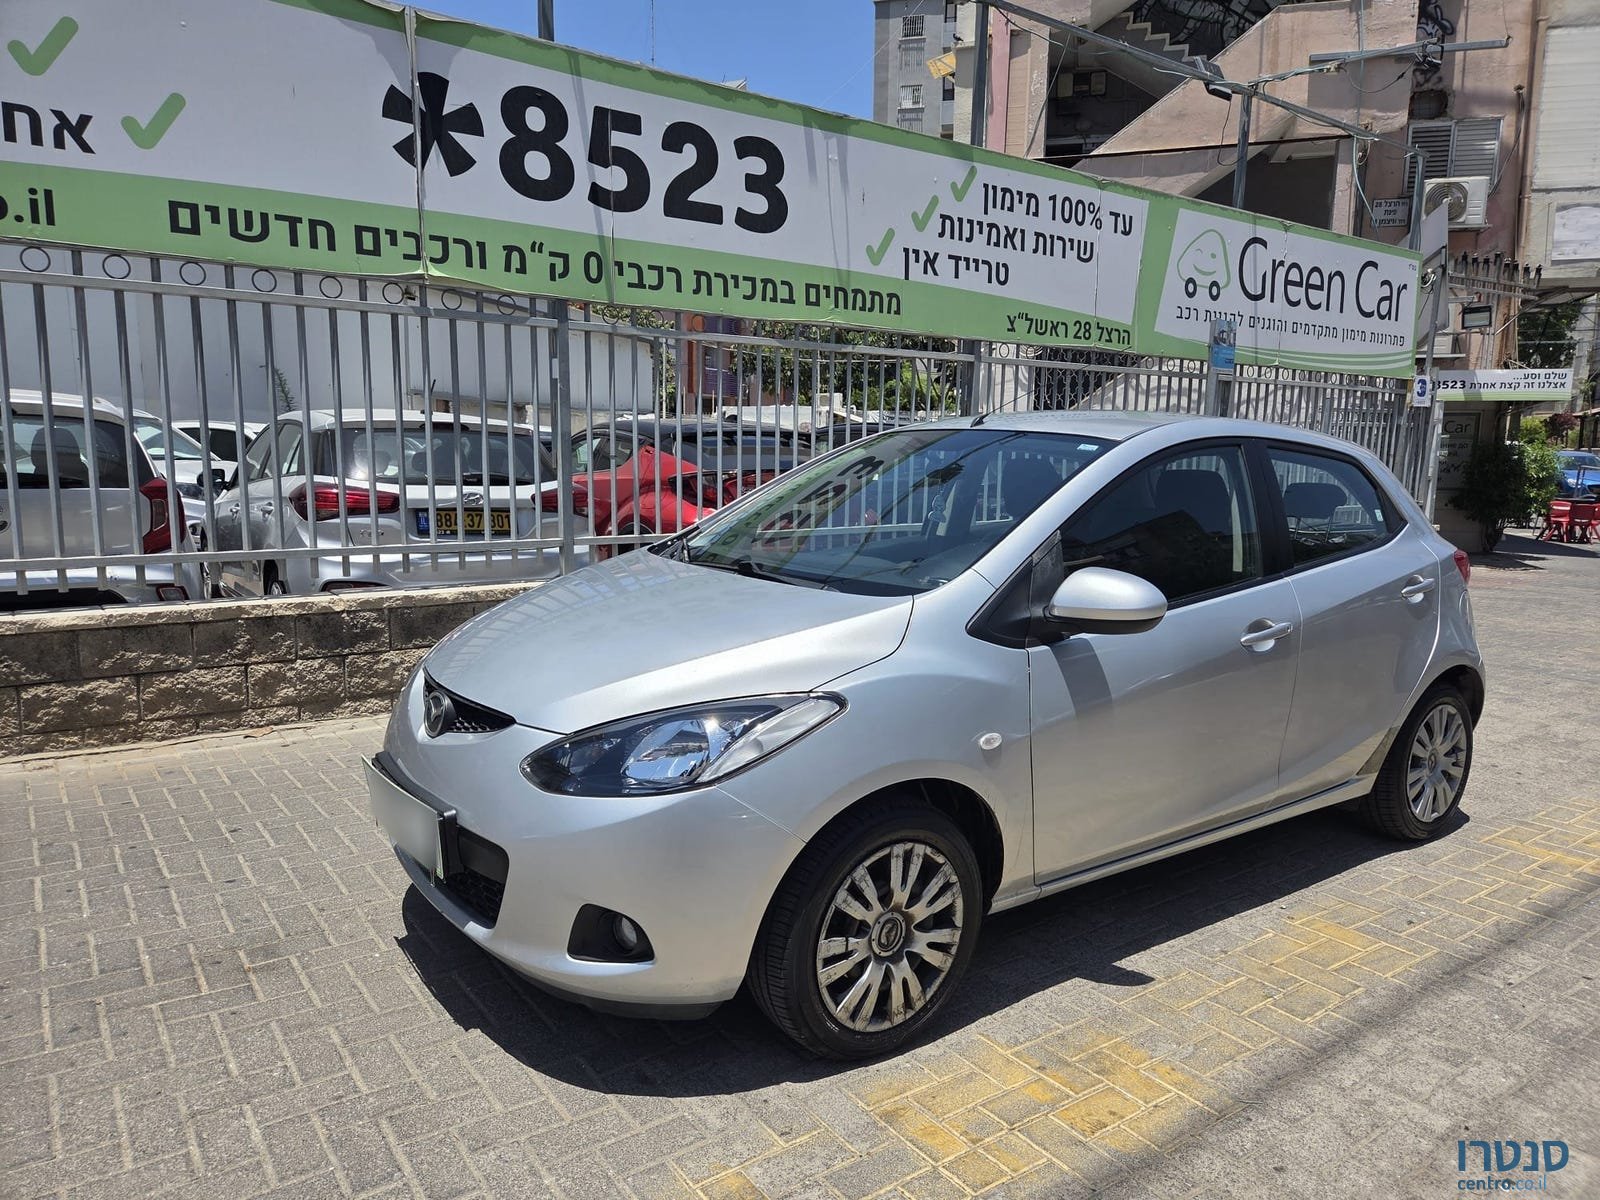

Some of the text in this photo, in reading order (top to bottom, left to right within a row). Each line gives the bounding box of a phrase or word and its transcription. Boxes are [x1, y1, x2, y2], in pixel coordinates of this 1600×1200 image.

[983, 182, 1133, 237] עד 100% מימון
[168, 199, 337, 252] חדשים
[355, 224, 487, 270] ורכבים
[938, 213, 1094, 264] שירות ואמינות
[583, 250, 604, 284] 0
[614, 260, 683, 293] רכבי
[902, 247, 1010, 286] טרייד אין
[692, 269, 796, 305] במכירת
[1238, 236, 1408, 322] Green Car
[804, 282, 901, 316] מתמחים
[1175, 305, 1199, 322] רכב
[1249, 315, 1288, 332] והוגנים
[1072, 319, 1092, 341] 28
[1096, 321, 1131, 345] הרצל
[1292, 321, 1339, 340] מתקדמים
[1342, 327, 1367, 343] מימון
[1369, 331, 1405, 347] פתרונות
[1499, 381, 1521, 391] קצת
[1523, 381, 1536, 389] זה
[1538, 380, 1567, 389] אצלנו
[1544, 371, 1568, 380] שלם
[1444, 420, 1471, 434] Car
